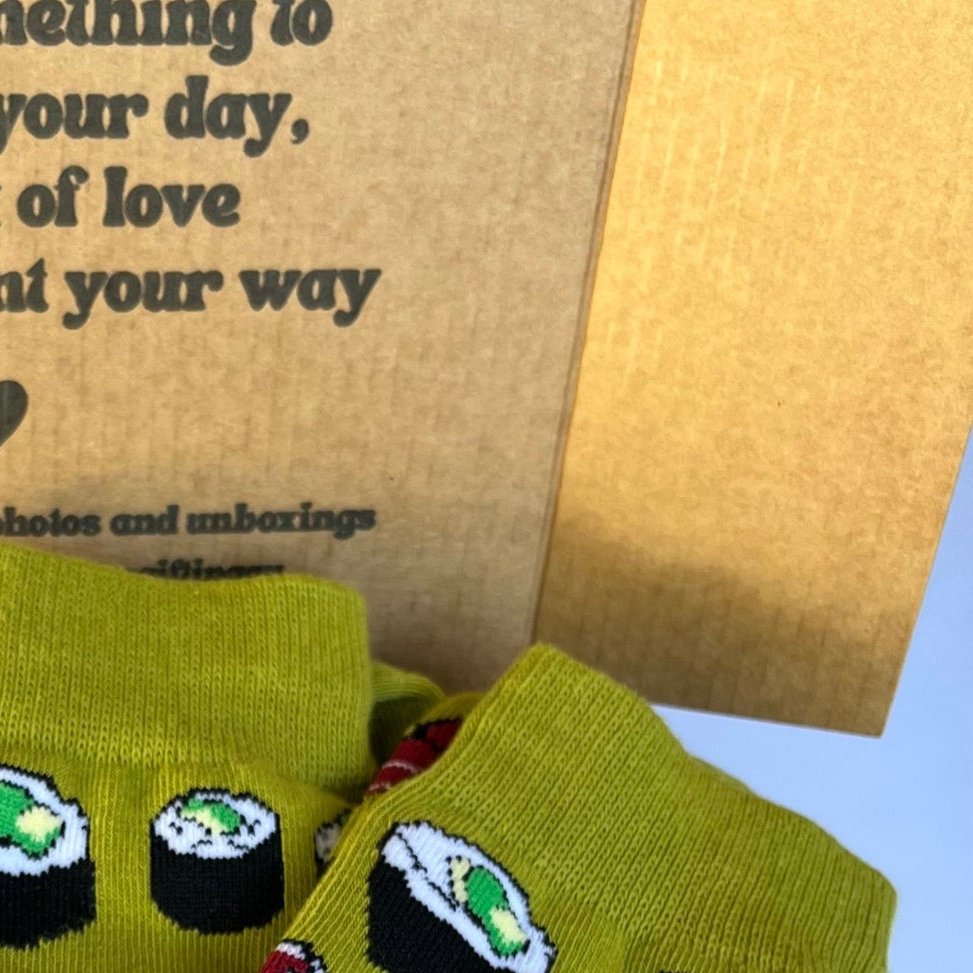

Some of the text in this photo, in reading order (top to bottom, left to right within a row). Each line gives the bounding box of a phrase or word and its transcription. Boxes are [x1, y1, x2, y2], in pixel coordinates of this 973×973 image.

[270, 0, 333, 46] to
[164, 75, 309, 158] day,
[17, 165, 89, 228] of
[102, 166, 241, 228] love
[62, 270, 224, 330] your
[239, 268, 382, 327] way
[110, 505, 179, 536] and
[185, 502, 376, 540] unboxings
